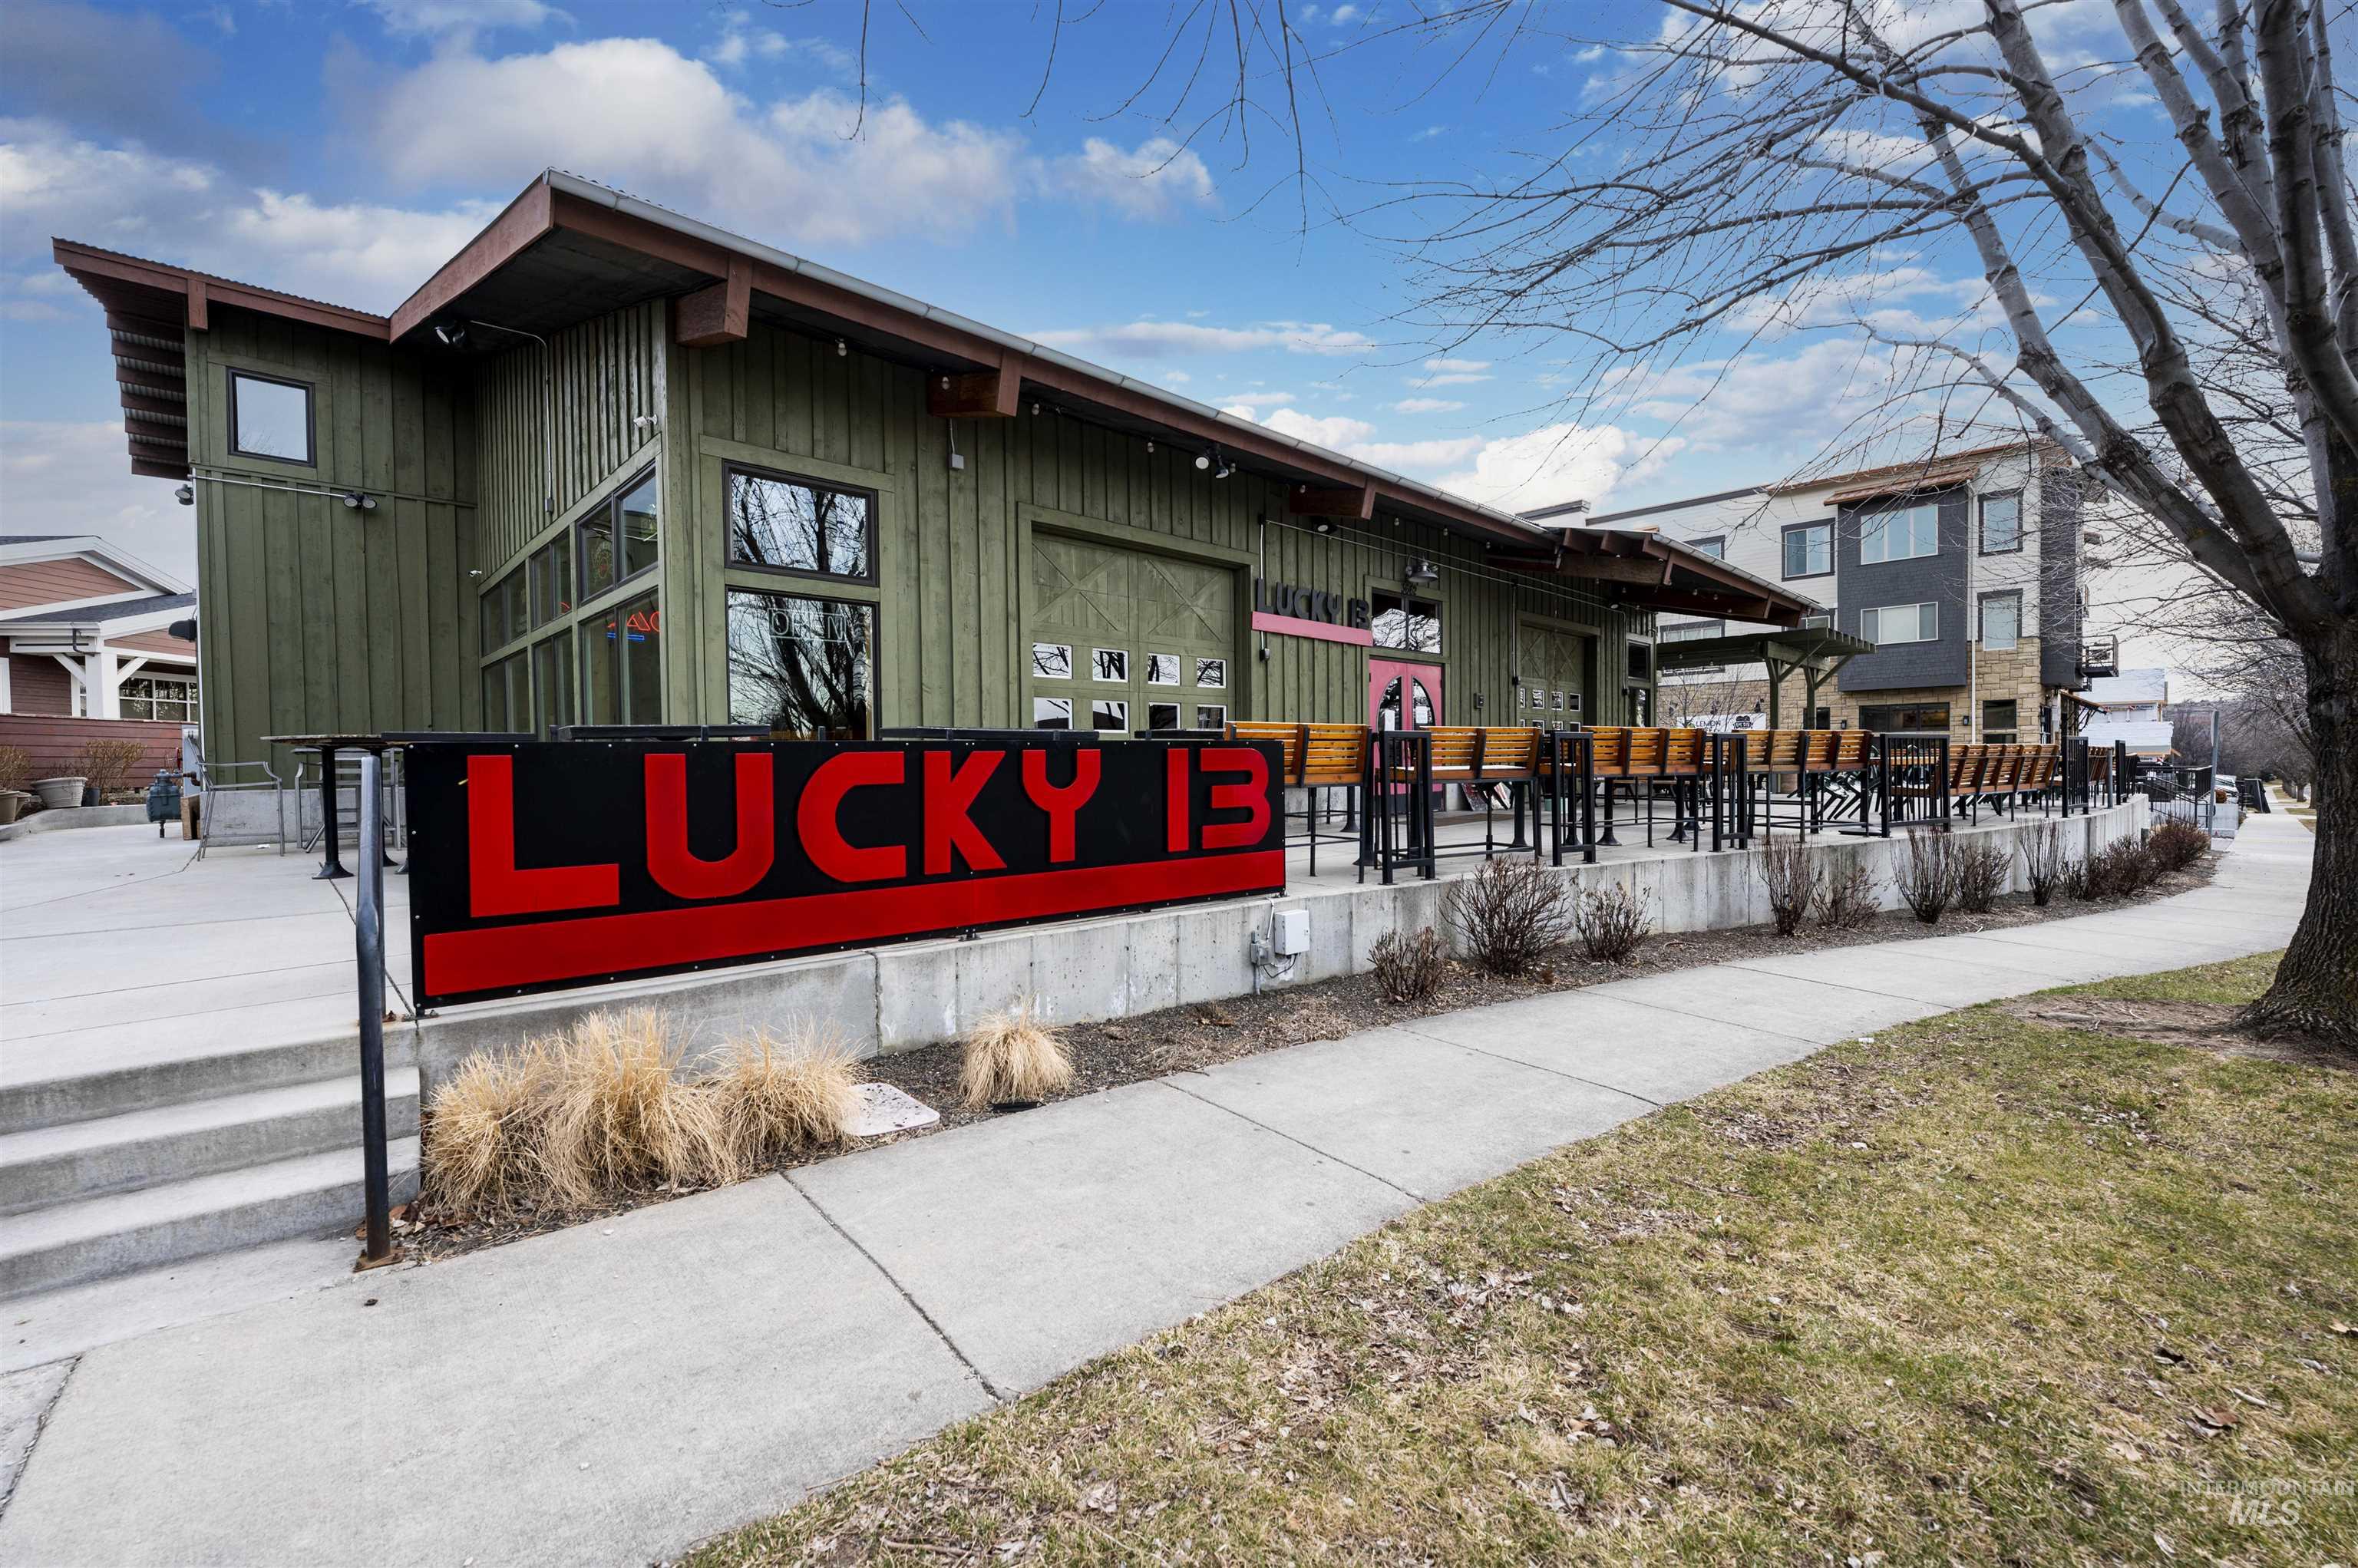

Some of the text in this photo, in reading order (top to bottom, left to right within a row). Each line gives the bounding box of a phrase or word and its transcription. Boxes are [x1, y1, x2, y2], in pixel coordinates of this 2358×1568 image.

[771, 611, 844, 639] OPEN
[1256, 577, 1370, 630] LUCKY 13
[467, 748, 1271, 917] LUCKY 13
